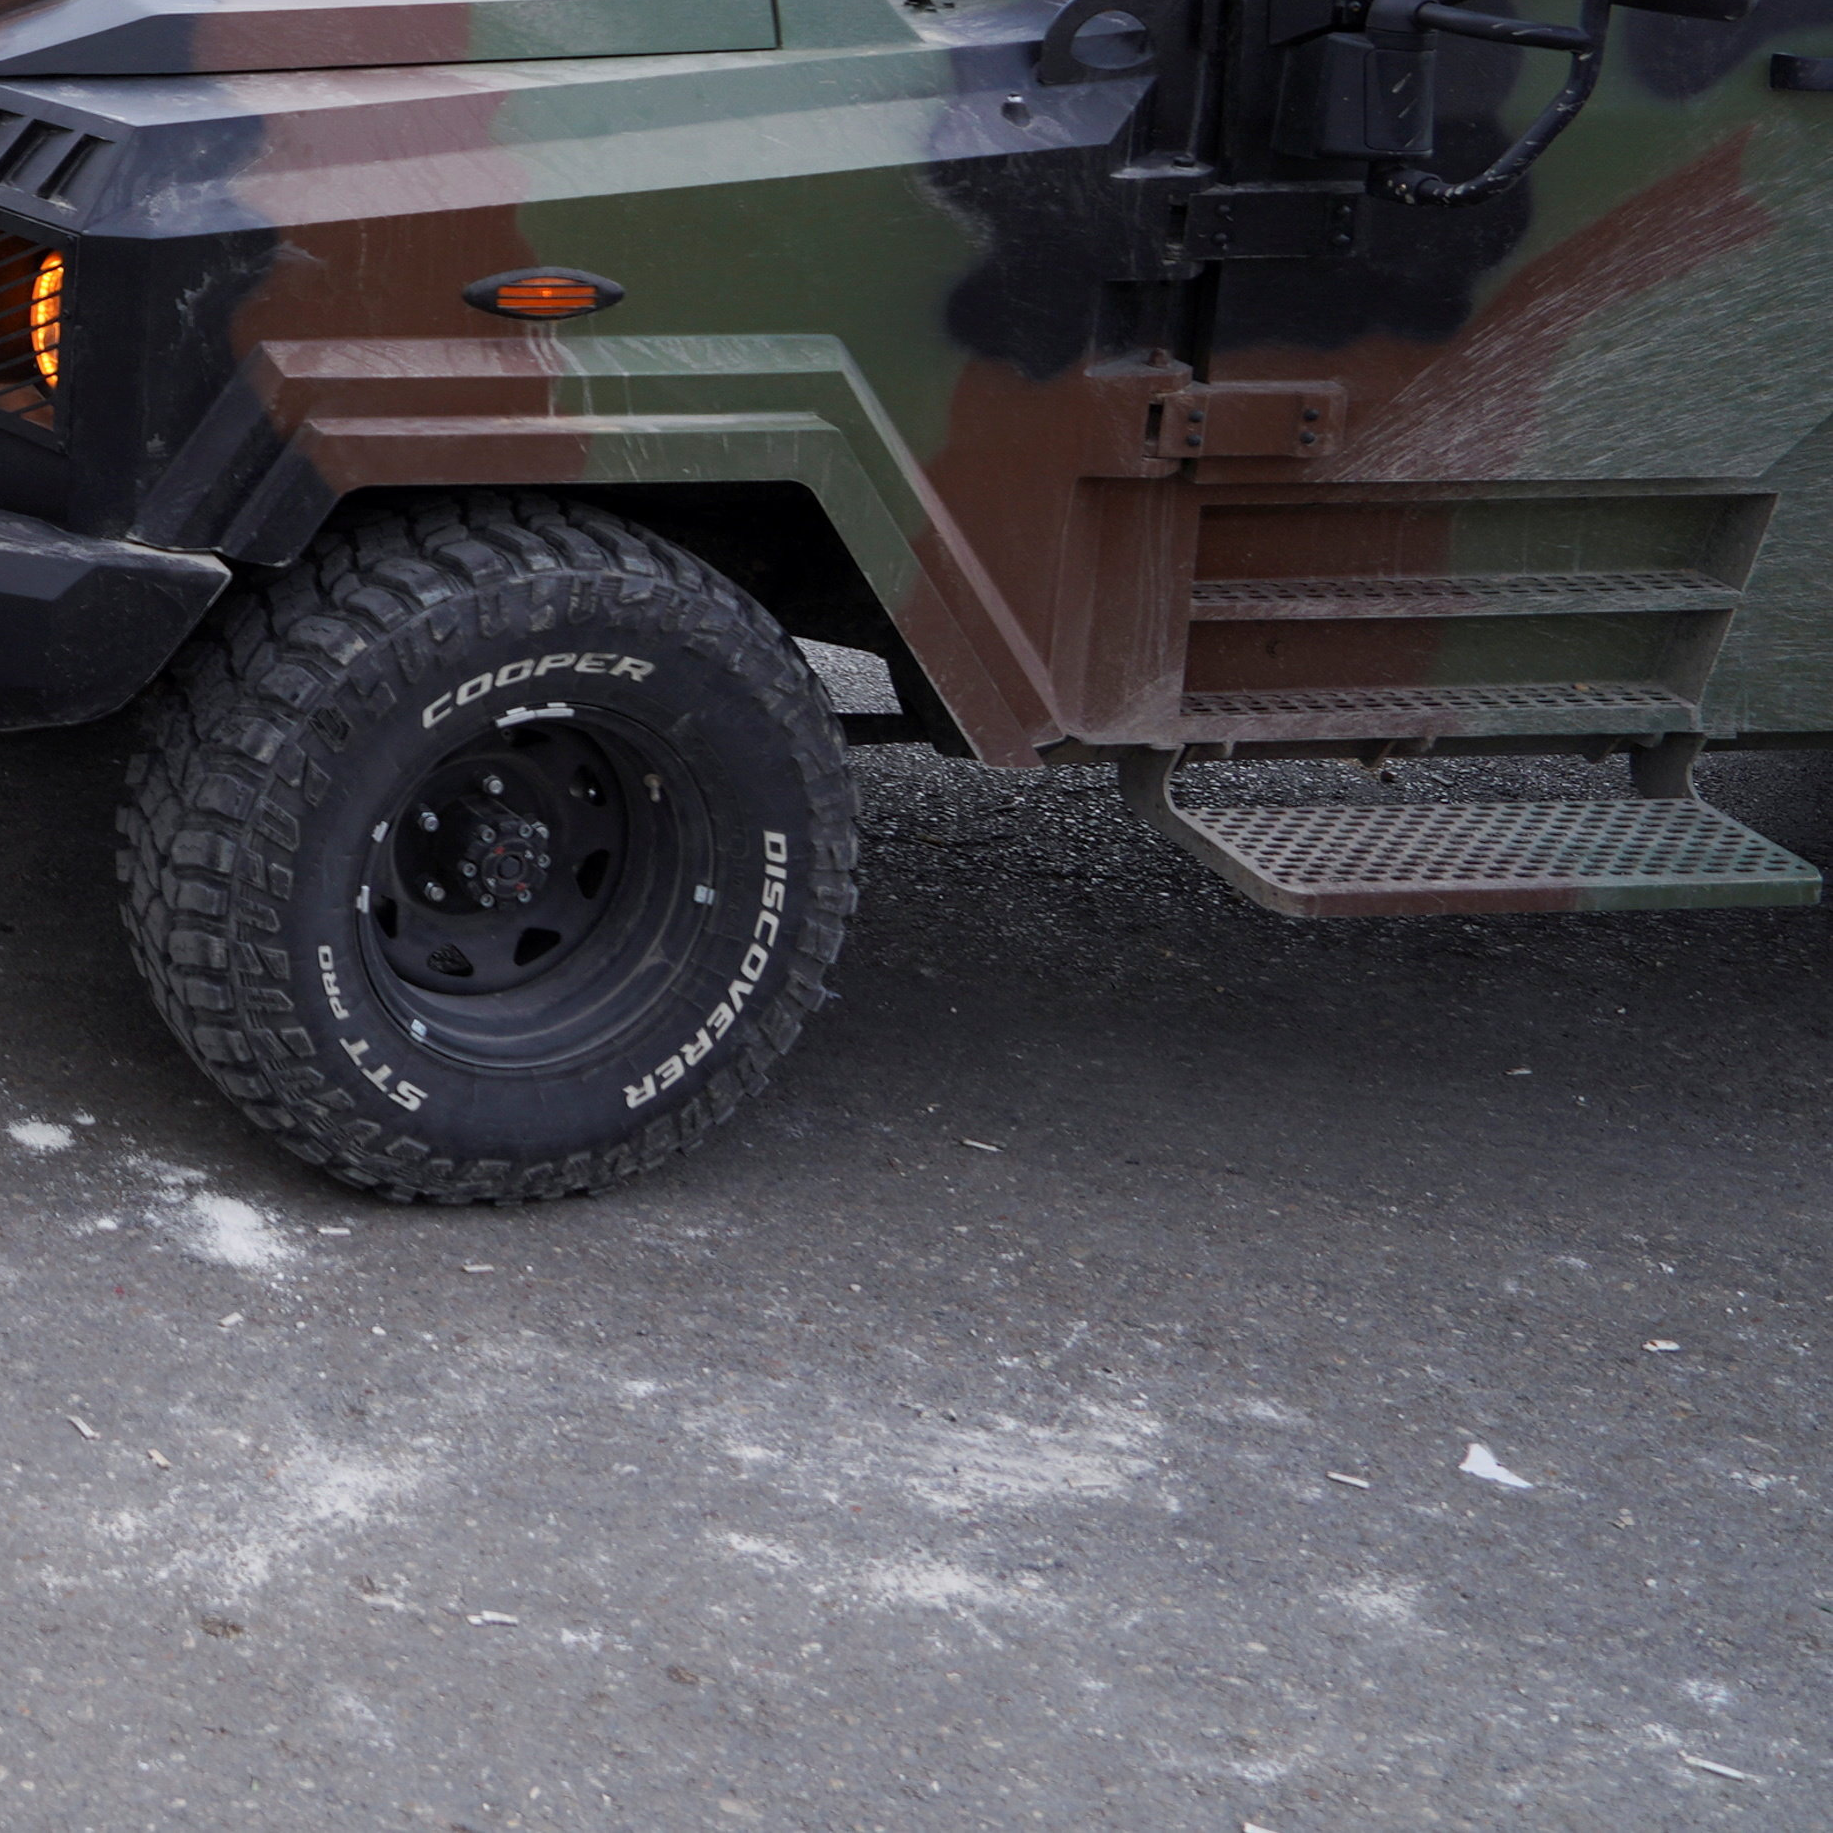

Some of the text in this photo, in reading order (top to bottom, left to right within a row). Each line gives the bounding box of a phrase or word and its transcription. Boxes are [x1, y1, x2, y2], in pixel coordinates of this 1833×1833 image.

[421, 652, 657, 730] COOPER
[318, 944, 429, 1114] STT PRO
[621, 829, 788, 1111] DISCOVERER
